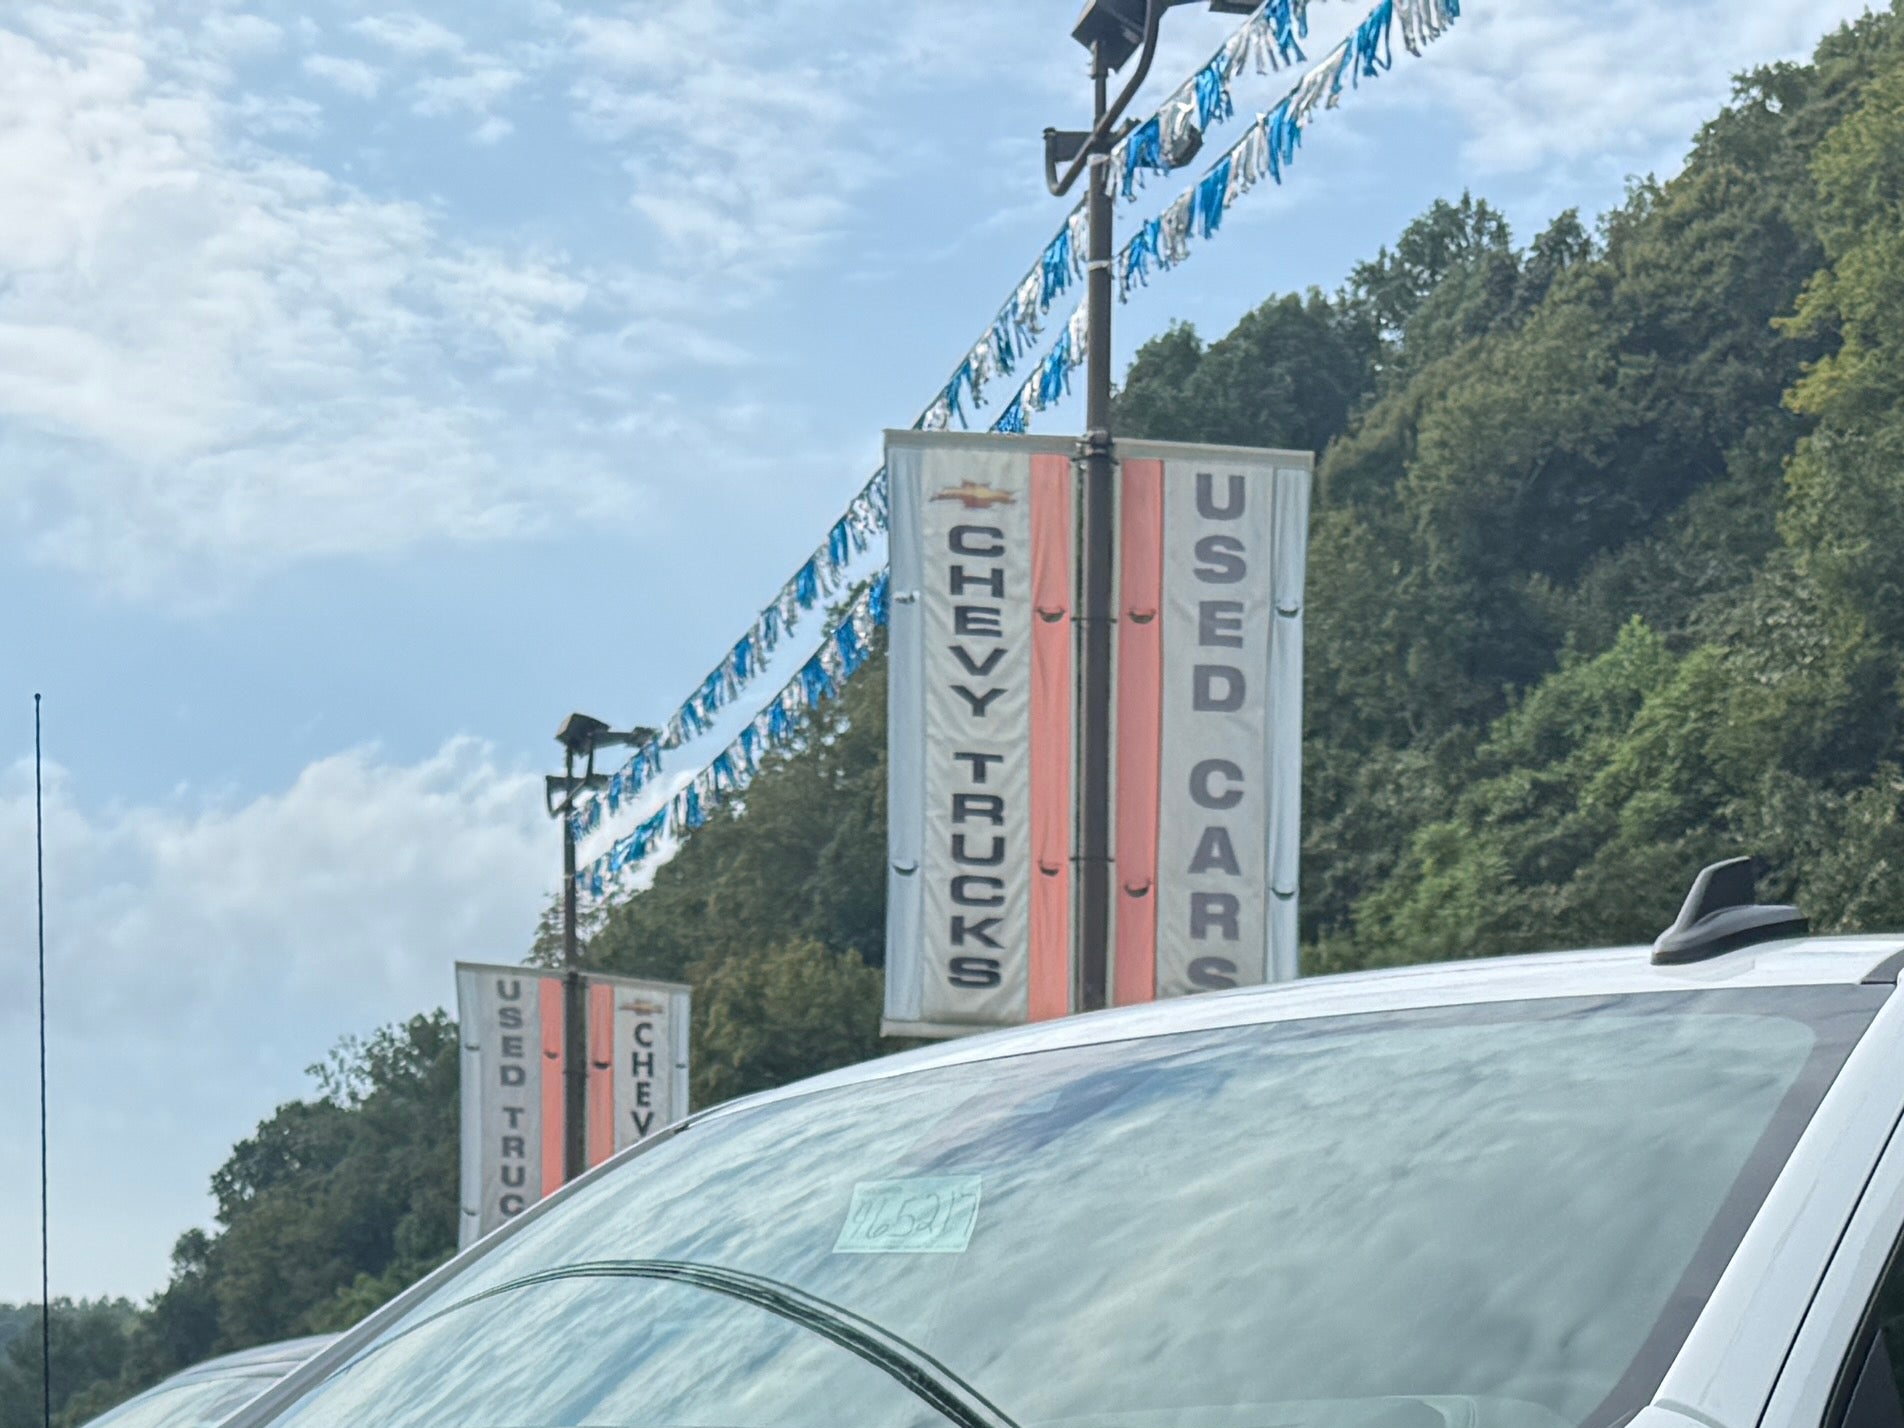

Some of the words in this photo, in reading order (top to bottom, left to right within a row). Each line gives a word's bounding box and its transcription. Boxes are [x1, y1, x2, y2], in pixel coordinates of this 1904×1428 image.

[948, 523, 1006, 718] CHEVY
[1191, 472, 1247, 713] USED
[947, 752, 1006, 990] TRUCKS
[496, 979, 526, 1088] USED
